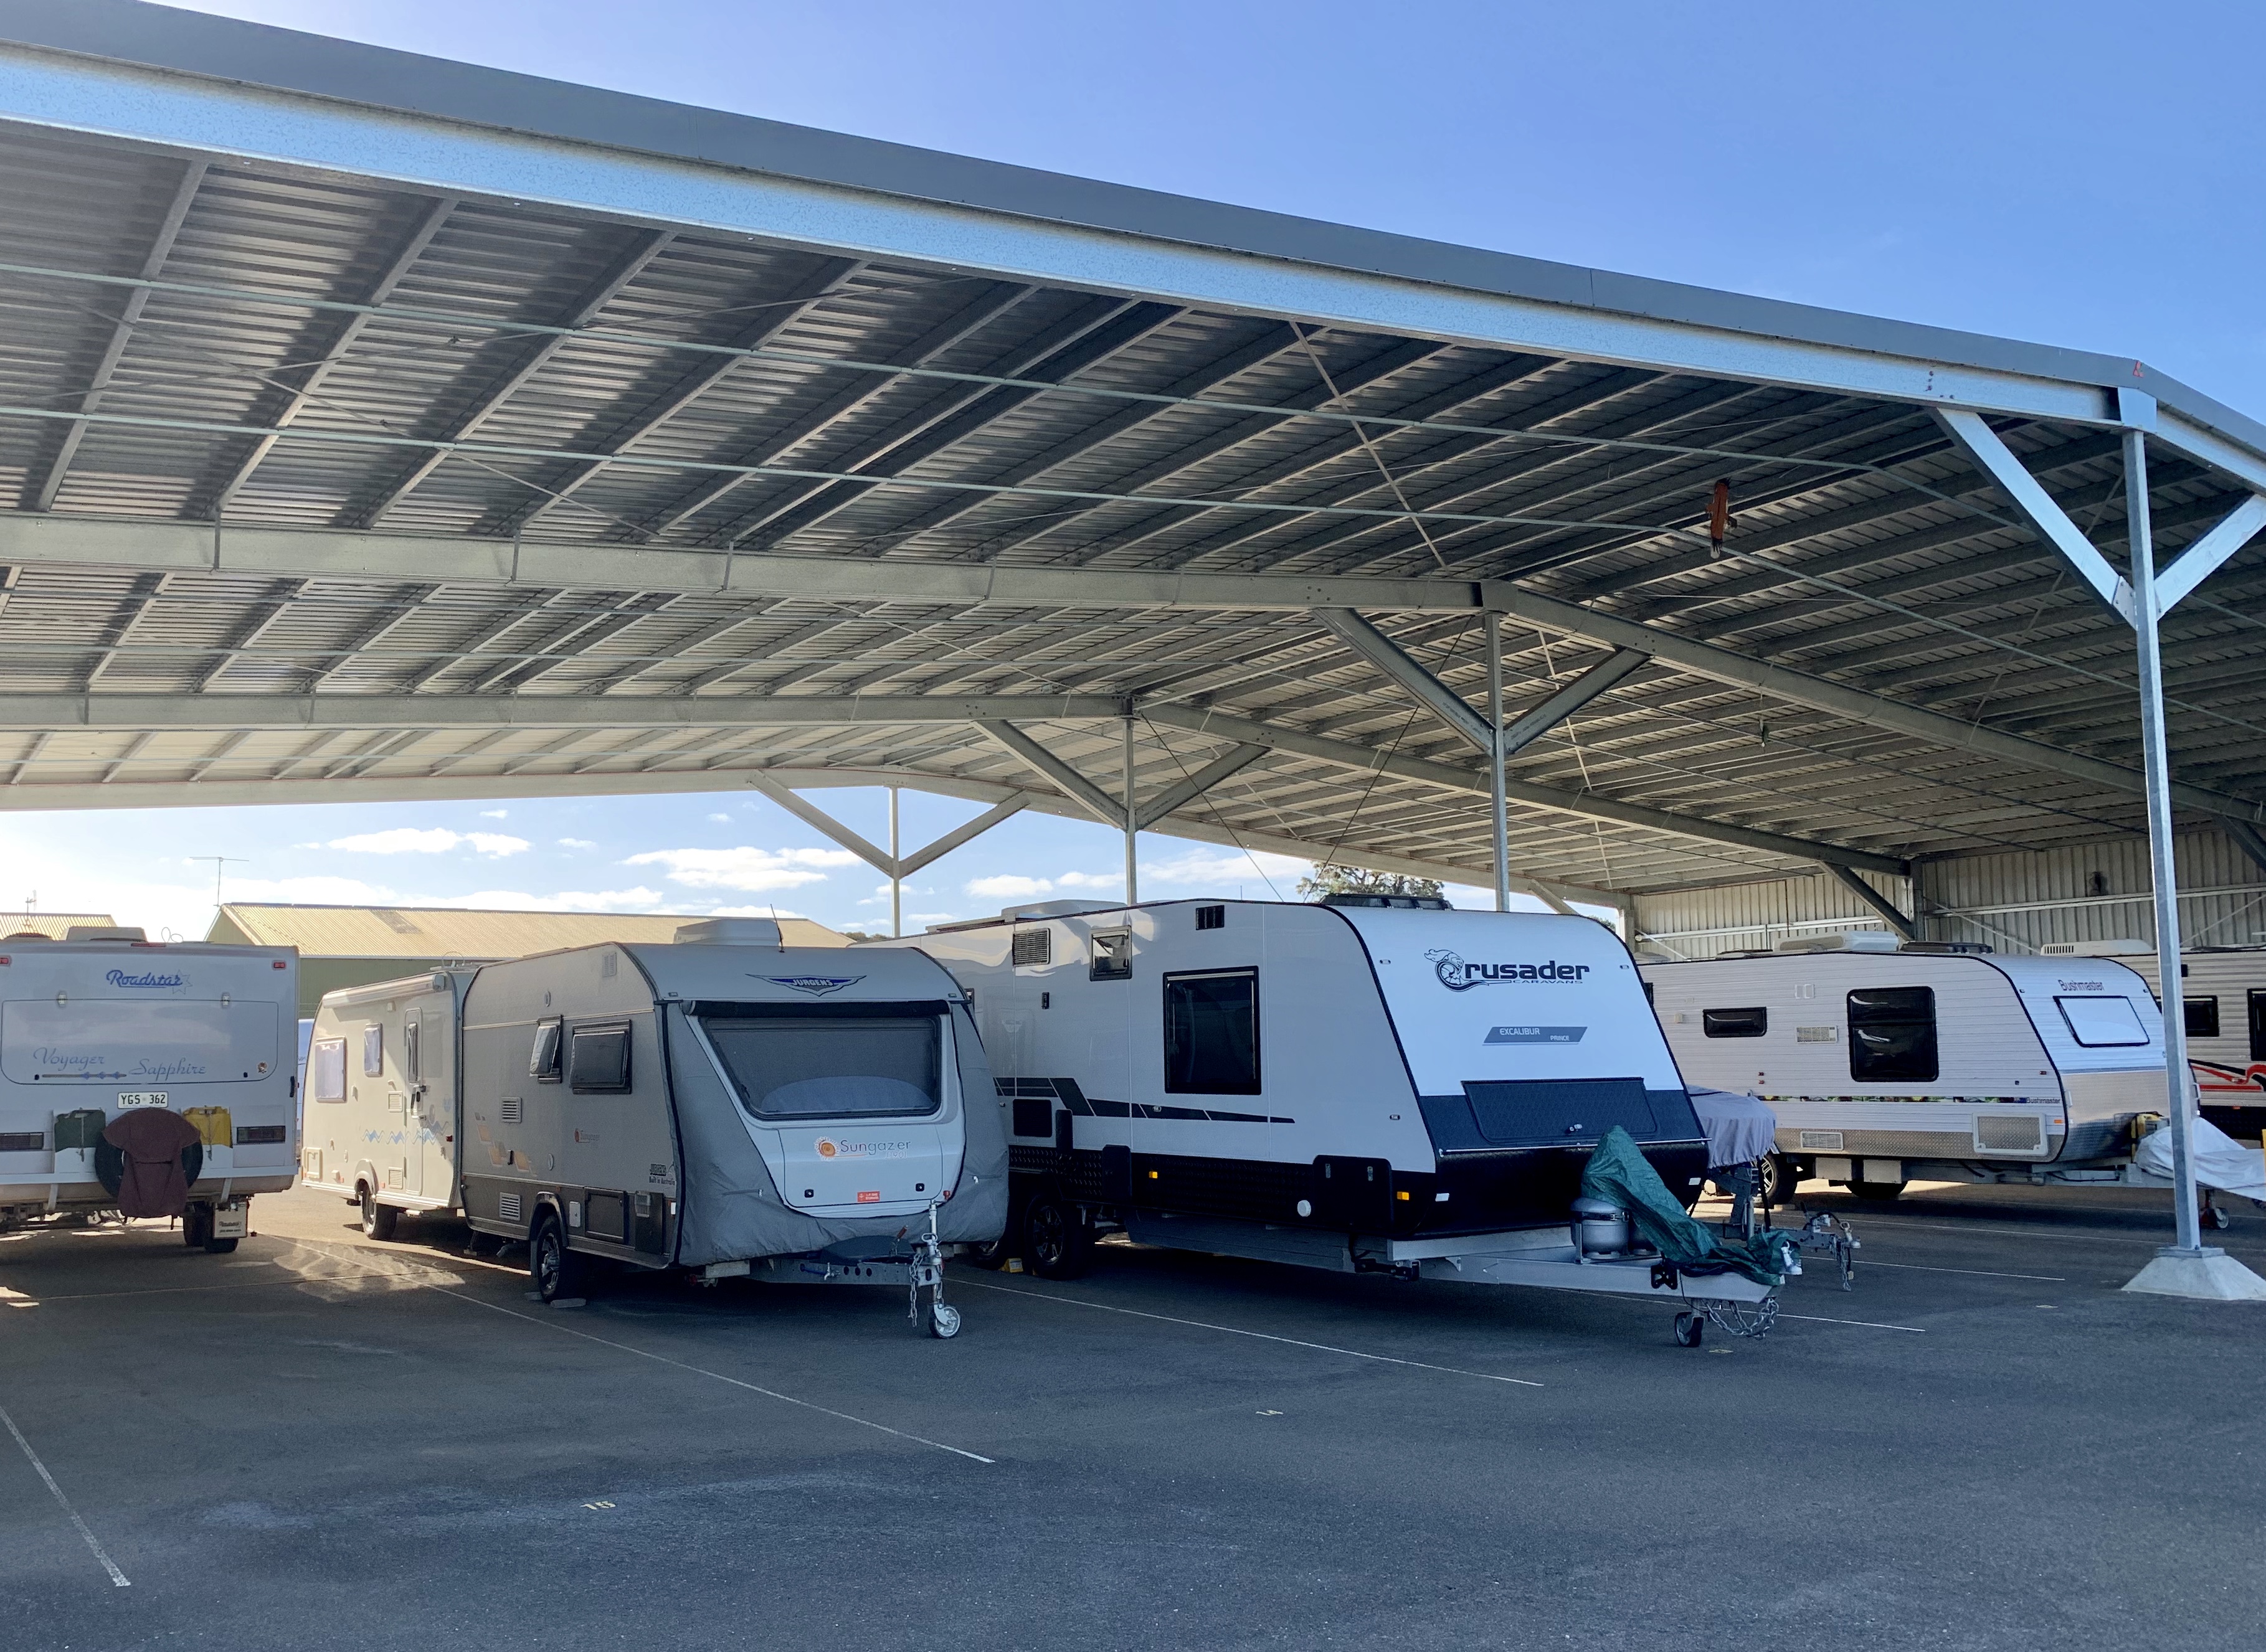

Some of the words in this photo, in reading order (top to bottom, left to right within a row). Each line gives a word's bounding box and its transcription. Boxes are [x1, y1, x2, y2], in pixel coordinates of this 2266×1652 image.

[106, 970, 183, 988] Roadstar
[1434, 960, 1590, 993] Crusader
[2058, 979, 2105, 991] Bushmaster
[33, 1047, 105, 1071] Voyager
[128, 1057, 206, 1081] Sapphire
[121, 1095, 140, 1105] YGS
[149, 1094, 166, 1104] 362
[841, 1140, 911, 1156] Sungazer
